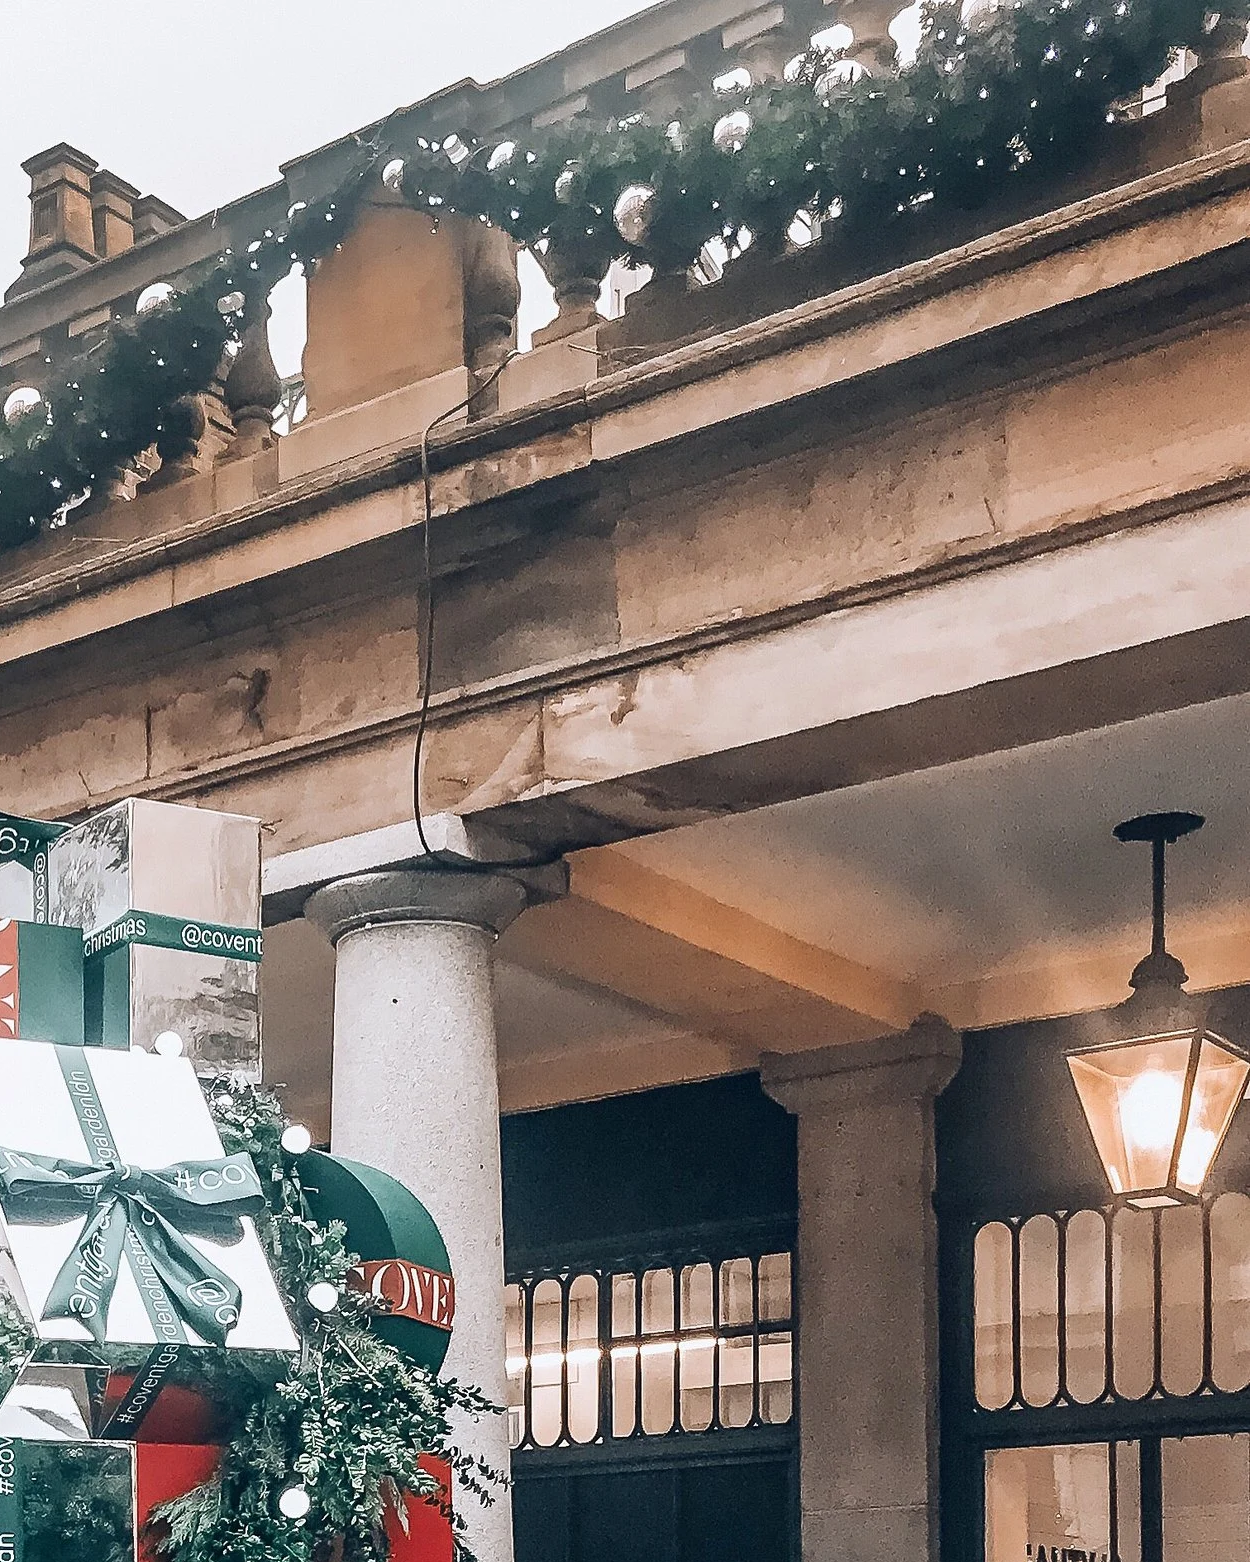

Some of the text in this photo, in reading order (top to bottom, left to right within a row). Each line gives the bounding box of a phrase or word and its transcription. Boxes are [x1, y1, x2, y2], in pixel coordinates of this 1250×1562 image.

[84, 917, 264, 958] christmas @covent
[352, 1261, 450, 1326] OVE
